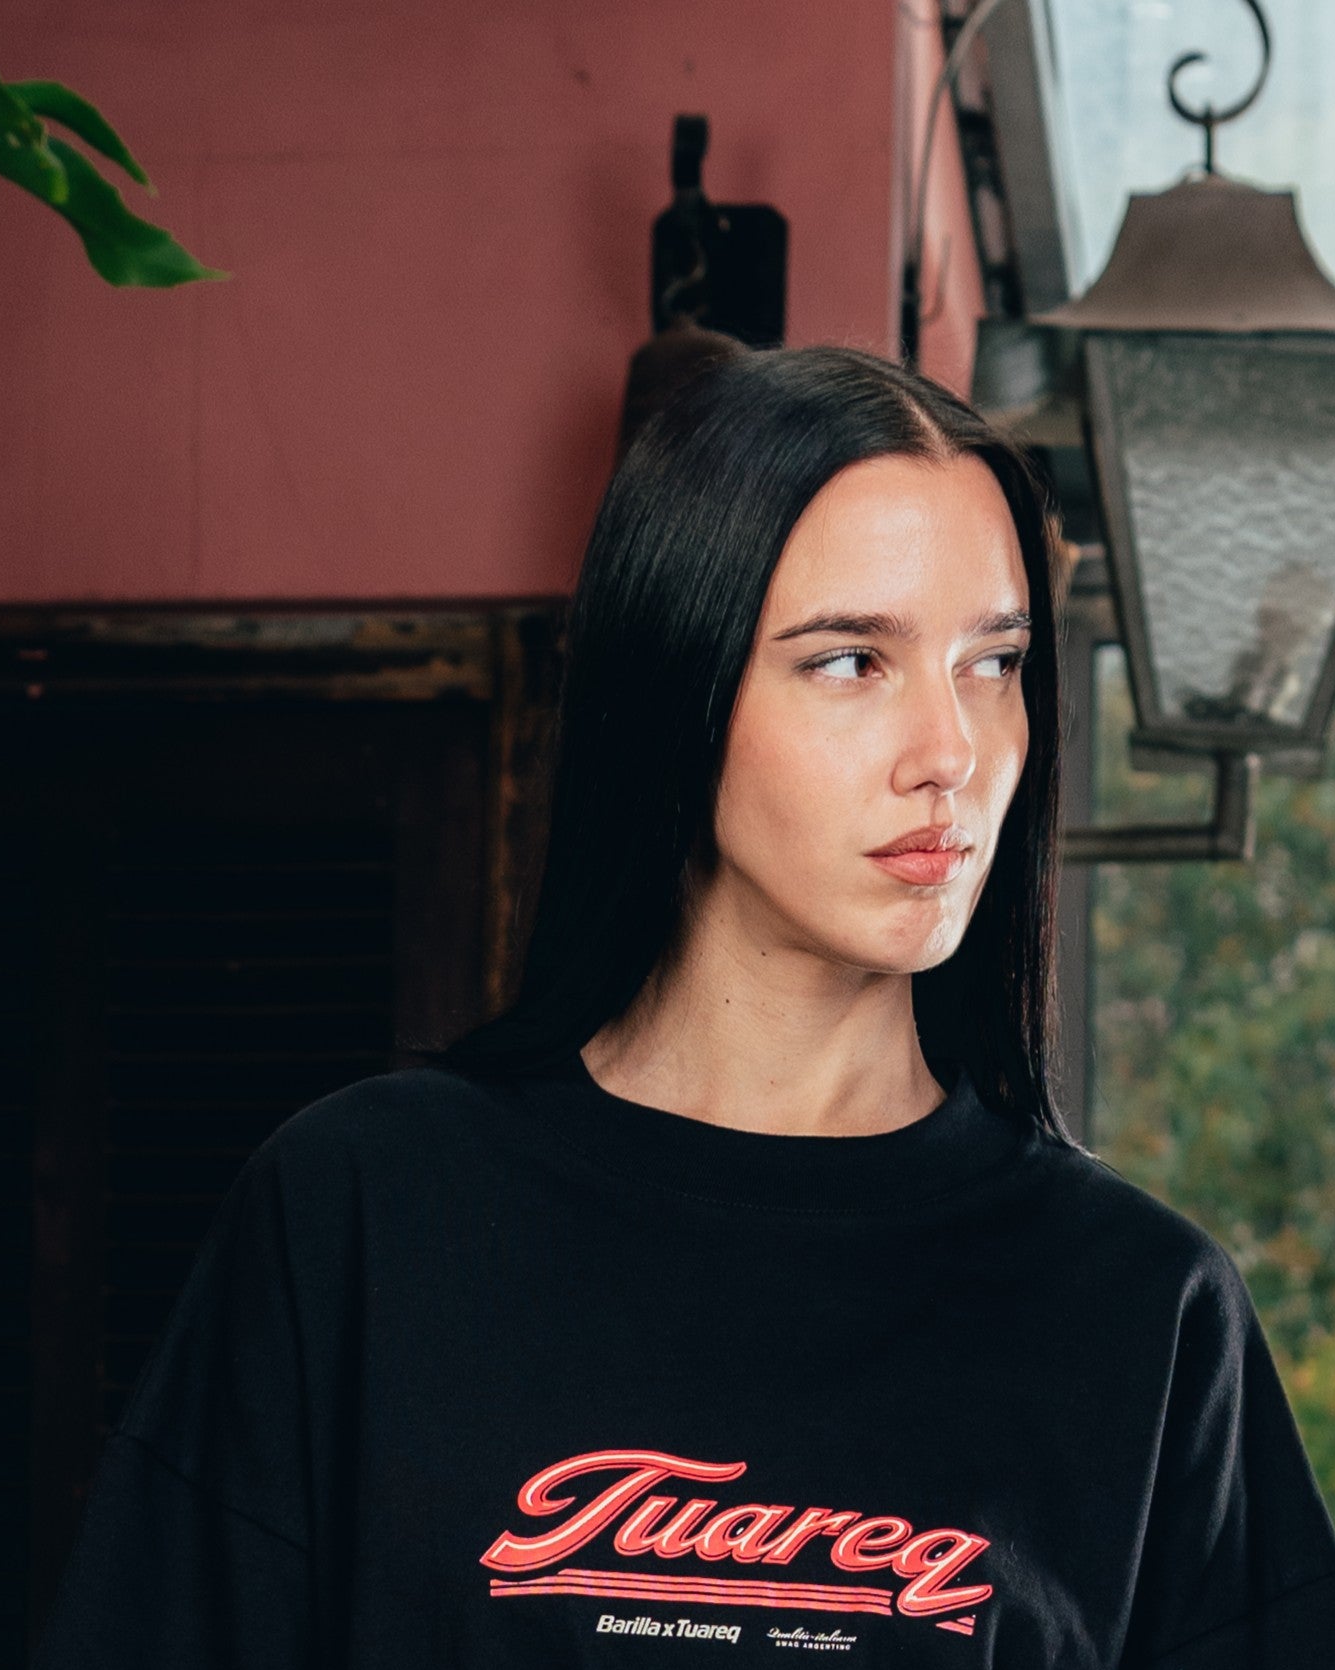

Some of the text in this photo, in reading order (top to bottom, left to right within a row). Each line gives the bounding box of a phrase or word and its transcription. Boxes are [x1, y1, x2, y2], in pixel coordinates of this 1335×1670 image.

[596, 1614, 742, 1644] Barilla x Tuareq
